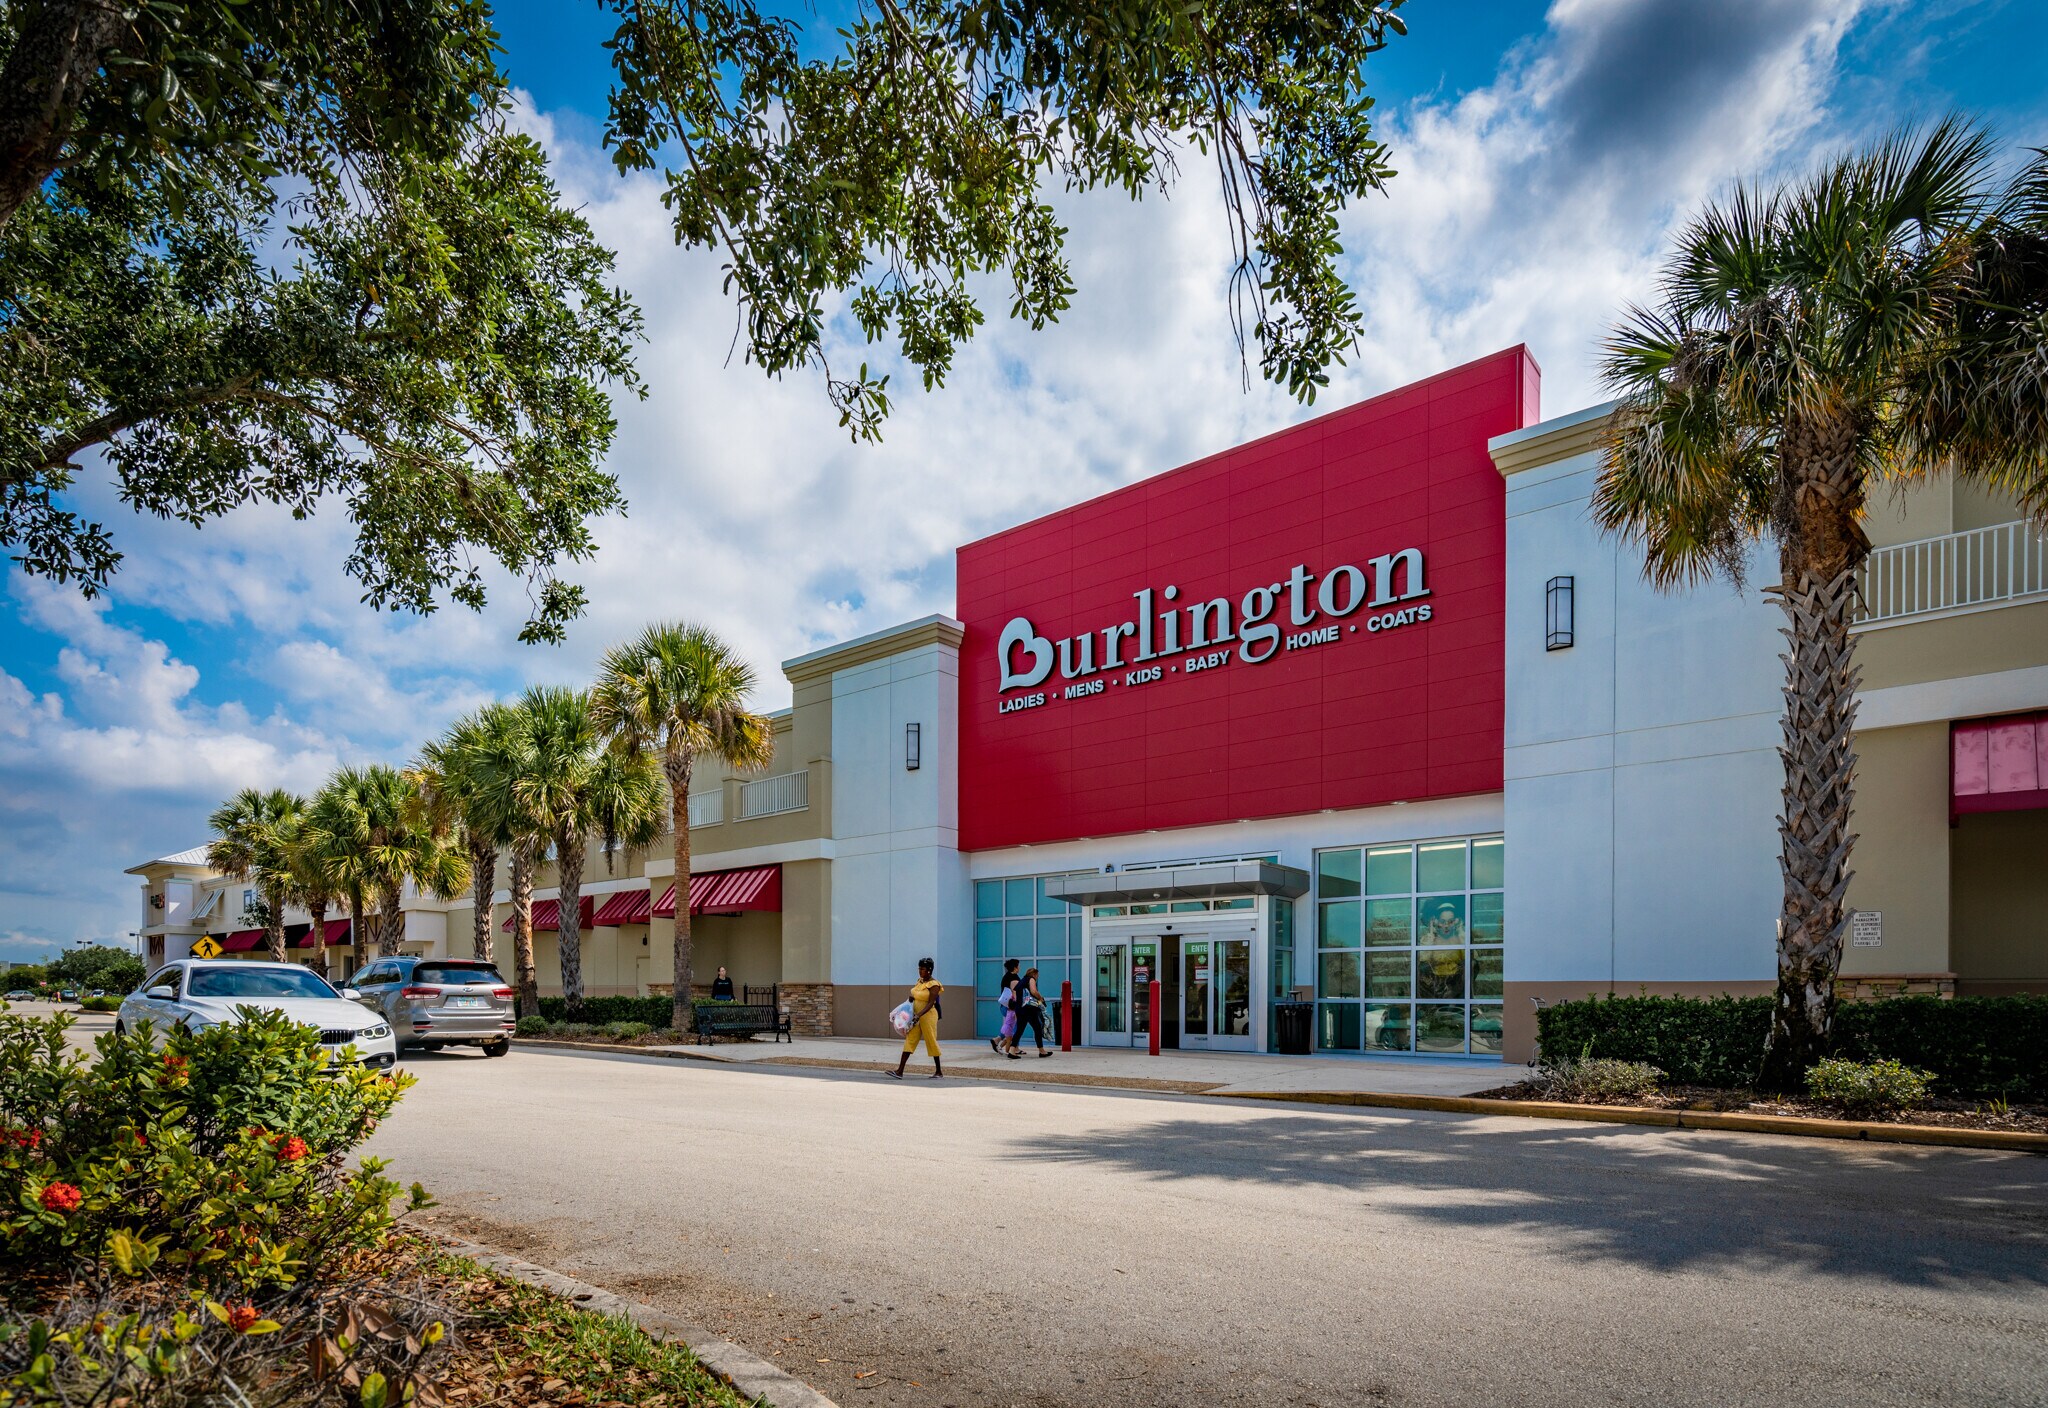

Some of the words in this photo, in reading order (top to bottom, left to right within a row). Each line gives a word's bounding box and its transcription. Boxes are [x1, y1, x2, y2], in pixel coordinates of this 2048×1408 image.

[998, 547, 1430, 693] Burlington
[999, 692, 1045, 714] LADIES
[1064, 679, 1104, 700] MENS
[1125, 666, 1162, 687] KIDS
[1185, 650, 1230, 673] BABY
[1286, 625, 1339, 650] HOME
[1367, 604, 1432, 632] COATS
